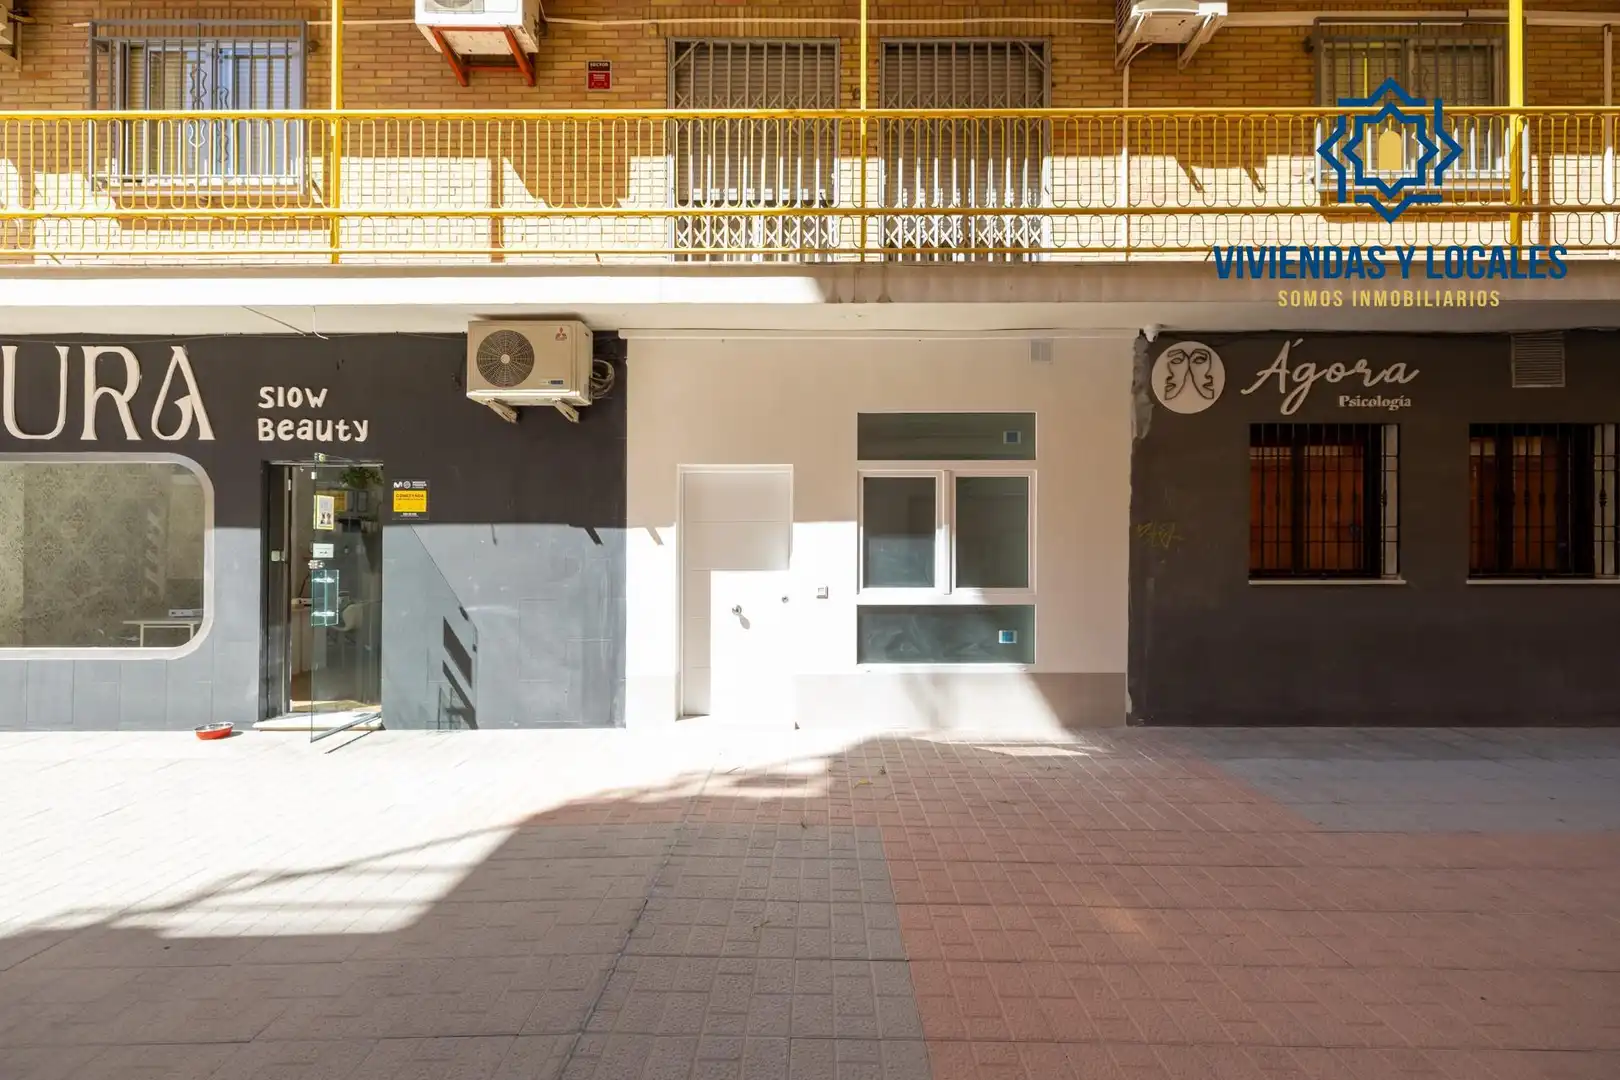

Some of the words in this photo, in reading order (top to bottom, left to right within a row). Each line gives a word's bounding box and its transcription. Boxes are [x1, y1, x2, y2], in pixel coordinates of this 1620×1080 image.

[1240, 337, 1420, 416] Ágora
[2, 345, 216, 441] URA
[258, 386, 328, 409] Slow
[1338, 395, 1412, 411] Psicología
[257, 417, 369, 442] Beauty
